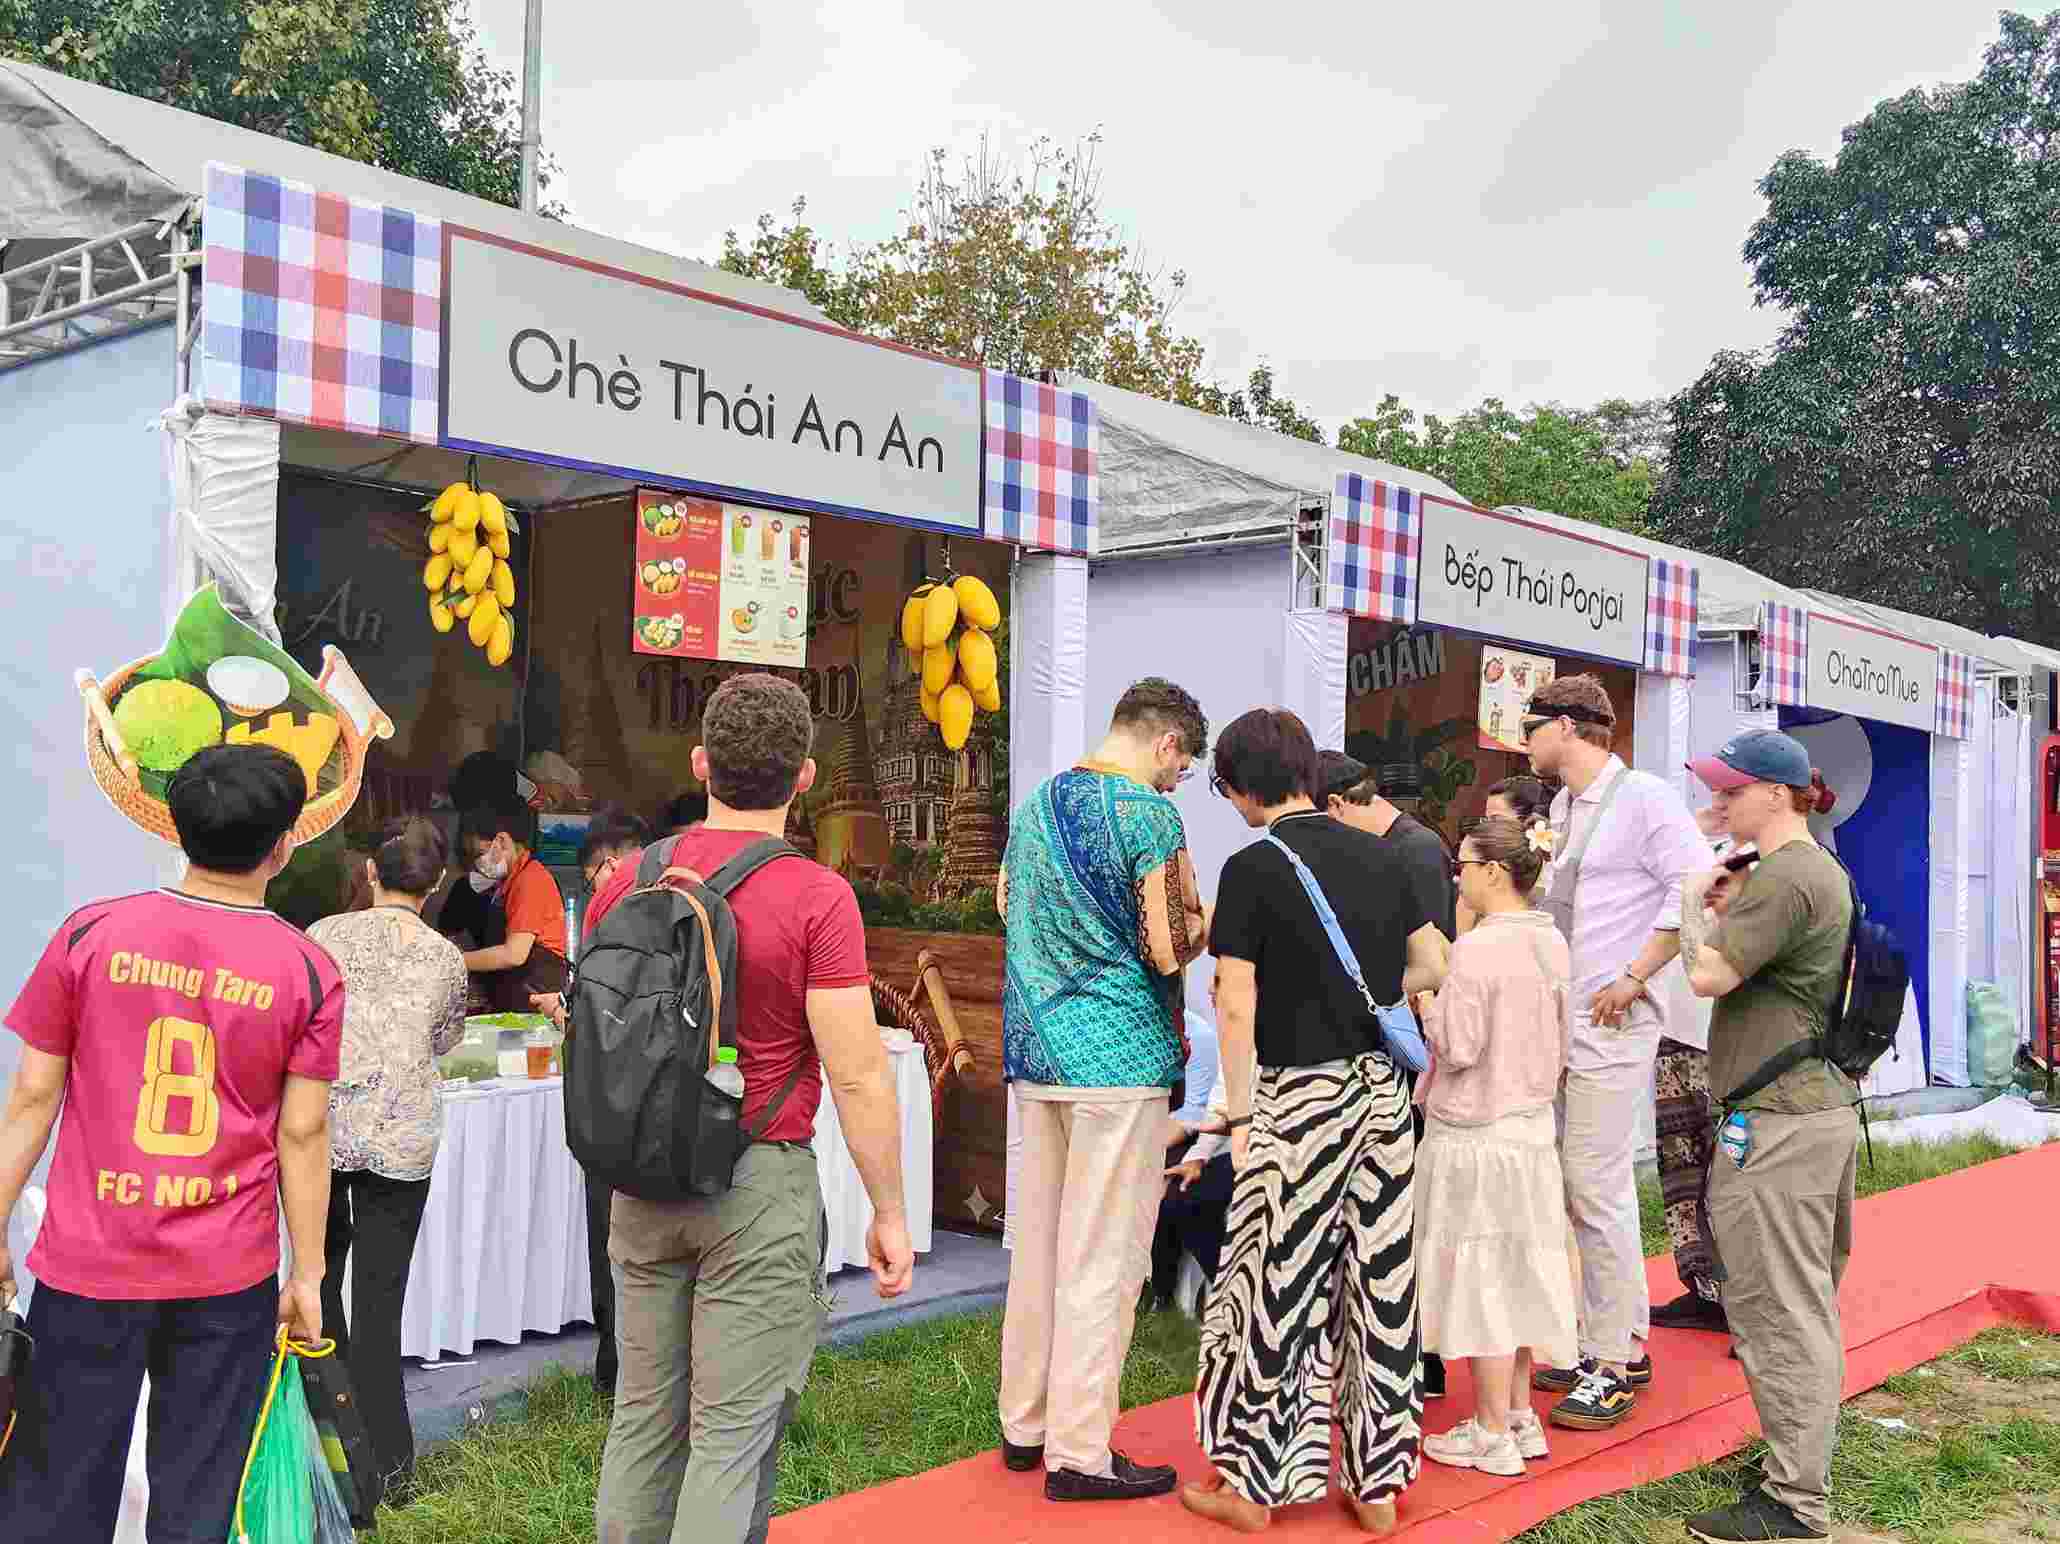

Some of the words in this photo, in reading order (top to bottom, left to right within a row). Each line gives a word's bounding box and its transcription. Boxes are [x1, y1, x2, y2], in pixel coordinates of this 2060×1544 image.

[508, 327, 642, 412] Chè
[659, 359, 776, 441] Thái
[792, 393, 865, 458] An
[878, 412, 944, 473] An
[1444, 543, 1494, 608] Bếp
[1501, 556, 1554, 607] Thái
[1560, 571, 1625, 631] Porjai
[109, 951, 205, 998] Chung
[212, 967, 275, 1011] Taro
[133, 1015, 220, 1157] 8
[96, 1168, 143, 1205] FC
